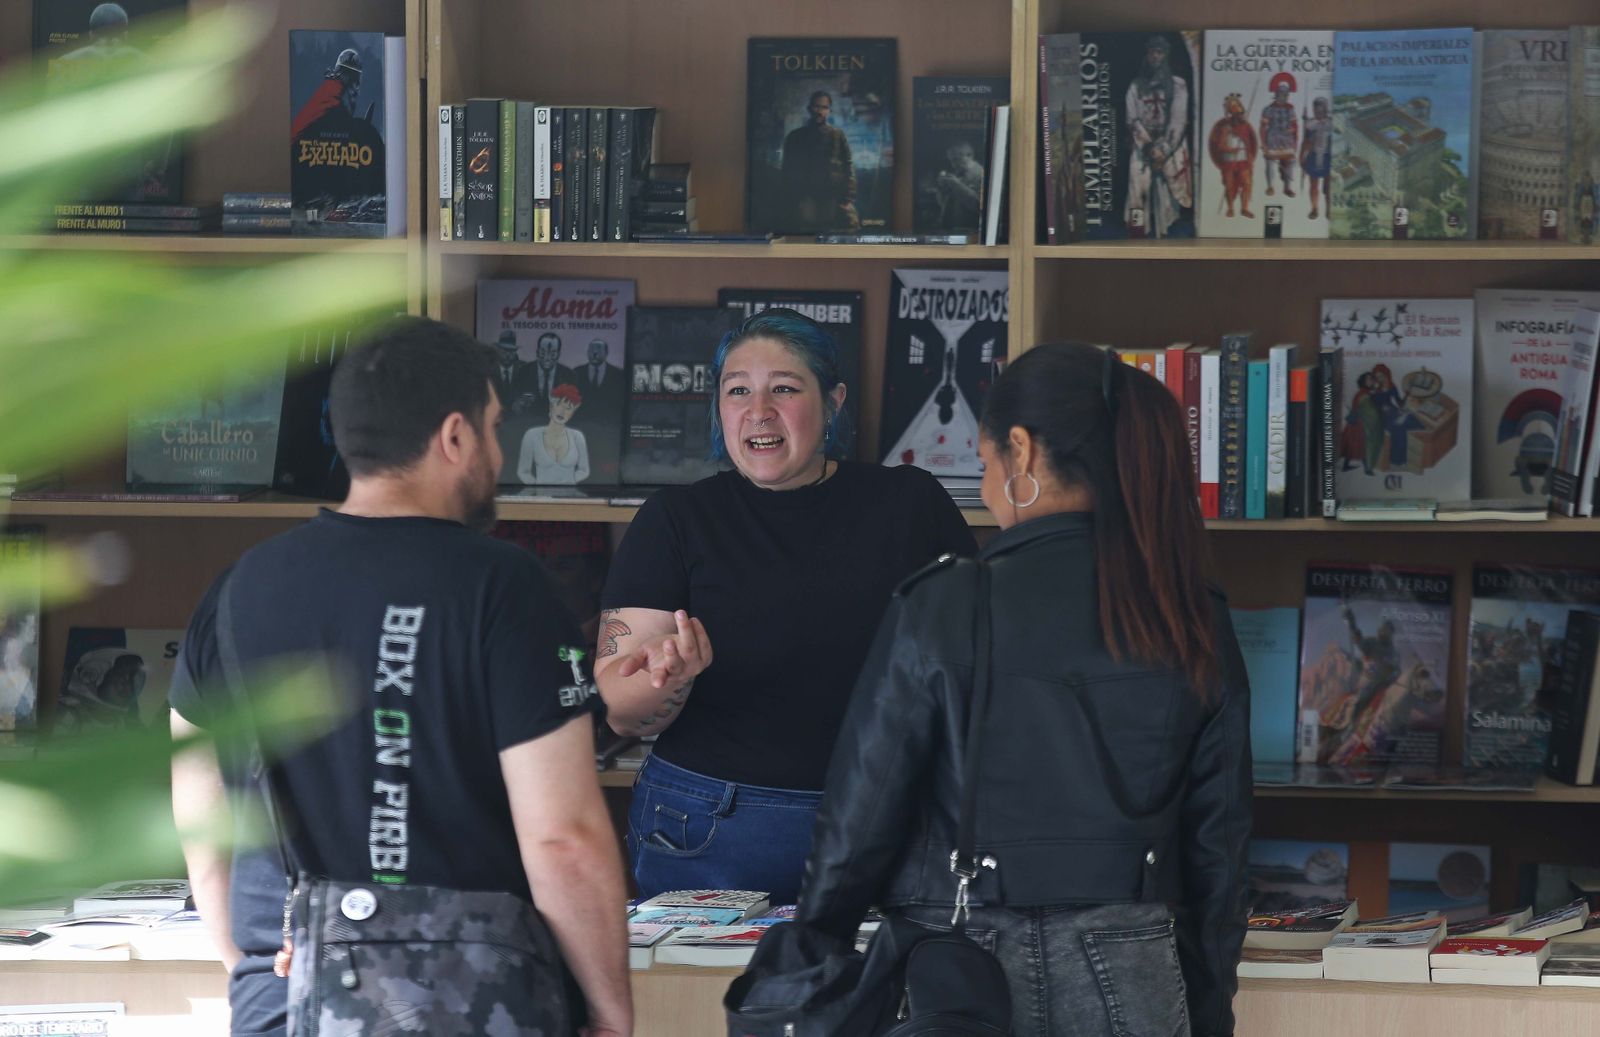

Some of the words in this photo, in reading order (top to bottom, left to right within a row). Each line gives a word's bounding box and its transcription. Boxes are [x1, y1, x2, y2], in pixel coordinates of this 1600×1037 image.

[1216, 44, 1236, 57] LA
[1244, 44, 1312, 58] GUERRA
[1341, 41, 1400, 52] PALACIOS
[1402, 38, 1470, 50] IMPERIALES
[771, 54, 865, 70] TOLKIEN
[1211, 58, 1272, 72] GRECIA
[1276, 59, 1286, 72] Y
[1292, 59, 1334, 72] ROM
[1341, 56, 1358, 67] DE
[1360, 56, 1376, 66] LA
[1418, 54, 1469, 66] ANTIGUA
[958, 85, 992, 94] TOLKIEN
[1099, 62, 1110, 99] DIOS
[1100, 102, 1110, 124] DE
[1080, 42, 1102, 225] TEMPLARIOS
[298, 140, 373, 170] EXILIADO
[1100, 128, 1112, 211] SOLDADOS
[55, 206, 83, 216] FRENTE
[84, 206, 94, 216] AL
[95, 206, 119, 216] MURO
[57, 219, 85, 229] FRENTE
[86, 219, 97, 229] AL
[97, 220, 121, 229] MURO
[502, 288, 618, 320] Aloma
[770, 302, 852, 324] MBER
[898, 286, 1008, 322] DESTROZADOS
[502, 321, 511, 330] EL
[513, 321, 548, 330] TESORO
[550, 321, 566, 330] DEL
[568, 321, 618, 331] TEMERARIO
[1510, 353, 1568, 365] ANTIGUA
[632, 364, 711, 393] NOI
[1520, 368, 1558, 379] ROMA
[1324, 384, 1332, 410] ROMA
[1324, 411, 1332, 422] EN
[161, 418, 254, 445] Caballero
[1270, 412, 1285, 475] GADIR
[1324, 424, 1333, 462] MUJERES
[173, 446, 257, 462] UNICORNIO
[1312, 573, 1386, 590] DESPERTA
[1398, 578, 1448, 593] FERRO
[373, 604, 426, 696] BOX
[1472, 711, 1552, 732] Salamina
[374, 708, 411, 768] ON
